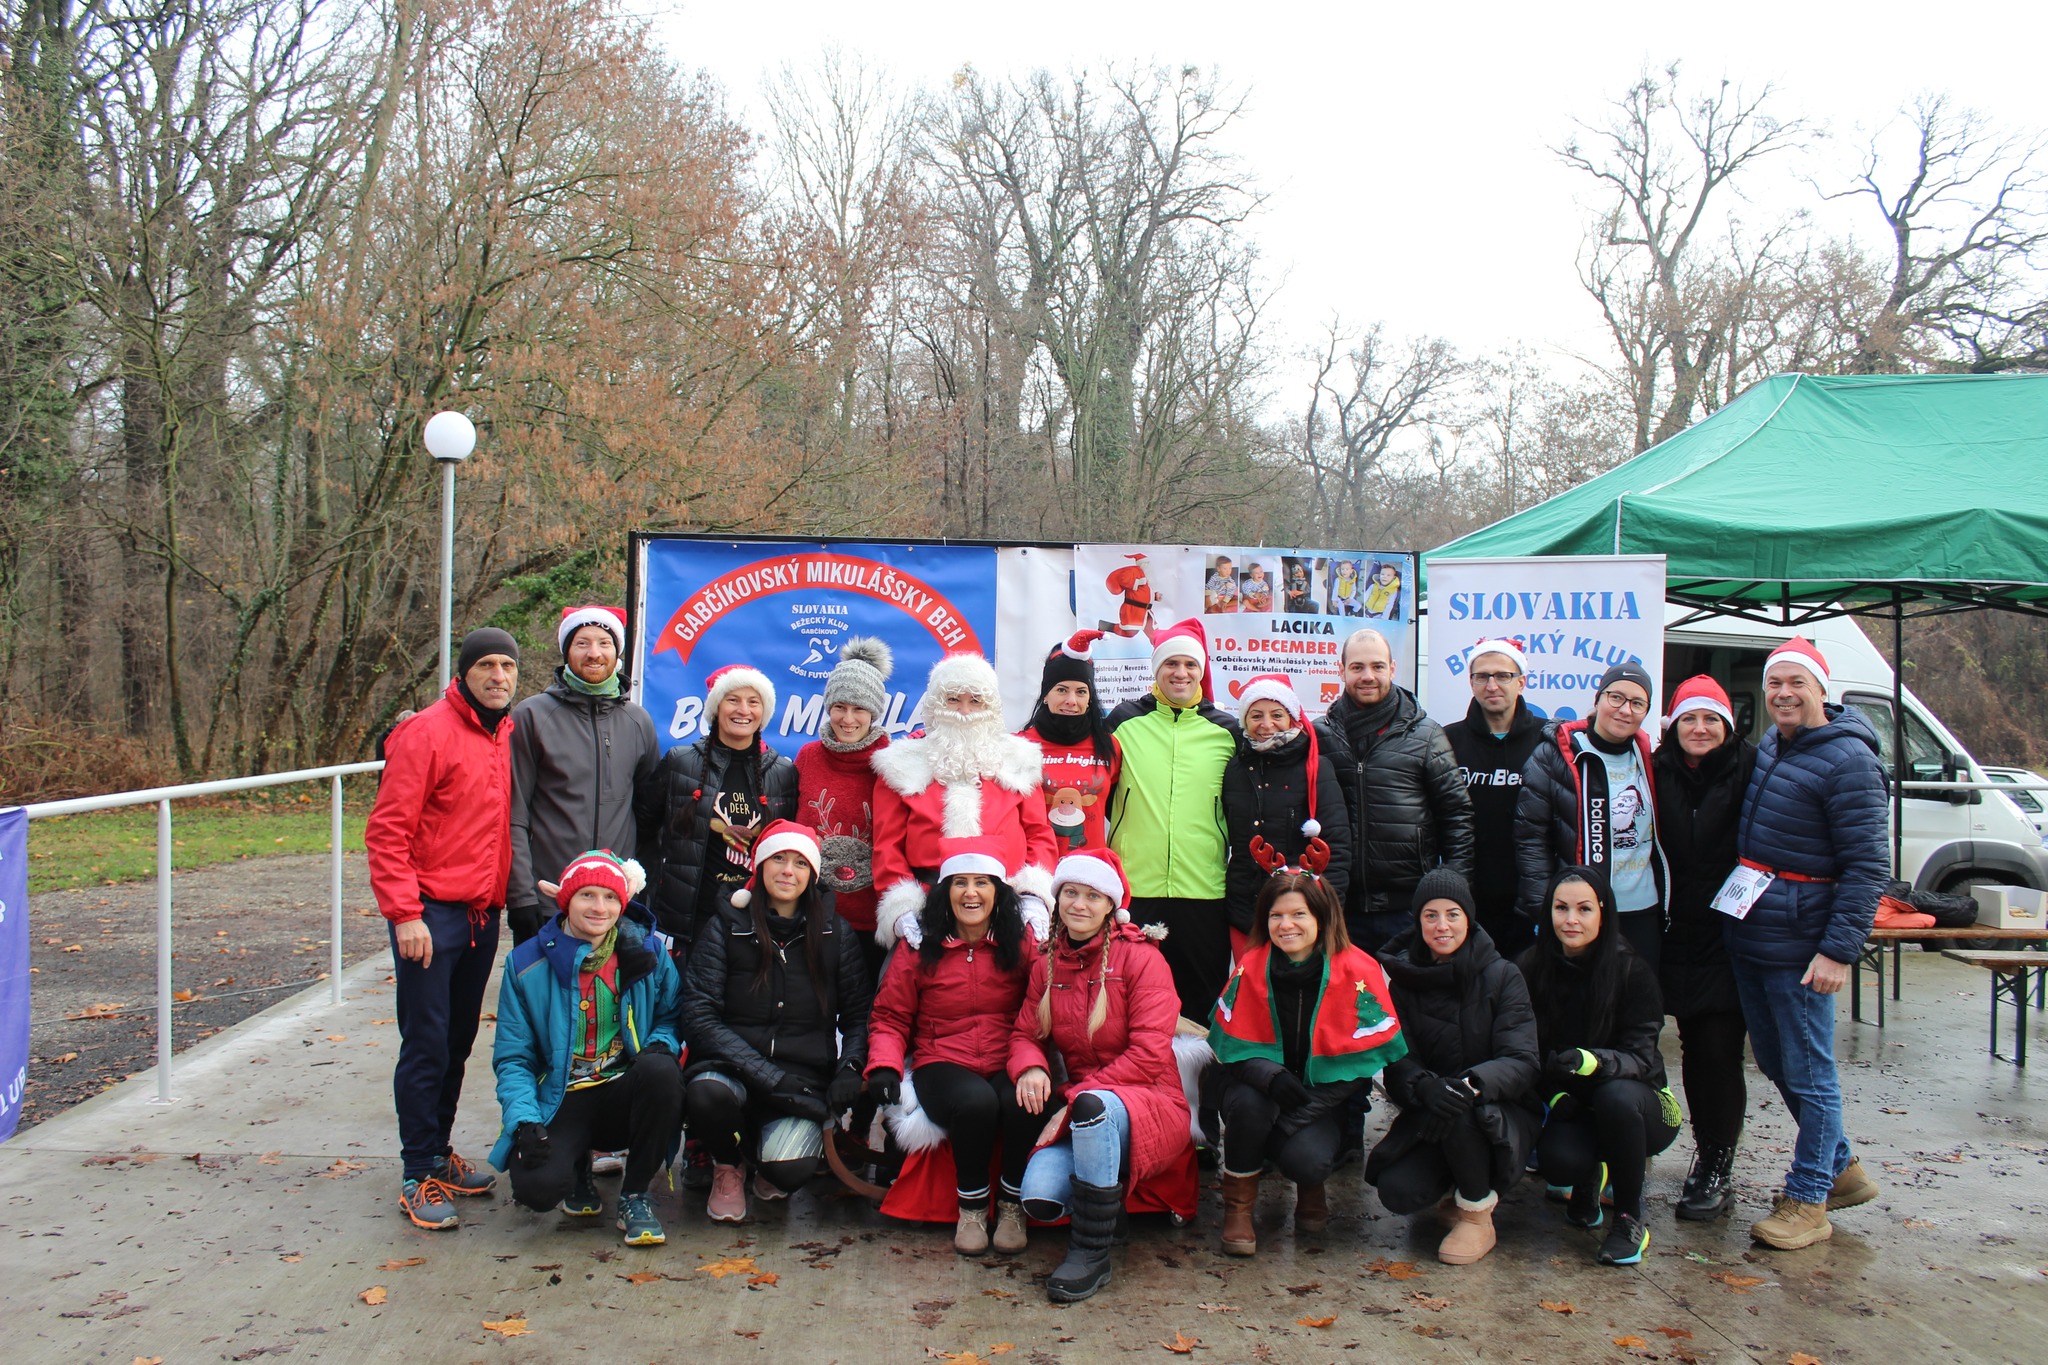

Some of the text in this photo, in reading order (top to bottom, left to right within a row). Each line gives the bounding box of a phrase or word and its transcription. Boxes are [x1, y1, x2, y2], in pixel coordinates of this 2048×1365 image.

[674, 558, 967, 648] GABČÍKOVSKÝ MIKULÁŠSKY BEH
[791, 604, 849, 615] SLOVAKIA
[1449, 591, 1641, 621] SLOVAKIA
[790, 615, 849, 632] BEŽECKÝ KLUB
[1271, 619, 1335, 635] LACIKA
[1215, 638, 1338, 655] 10. DECEMBER
[1268, 657, 1311, 667] Mikulášsky
[732, 792, 745, 802] OH
[729, 802, 751, 815] DEER
[1590, 798, 1606, 863] balance
[1724, 882, 1748, 900] 166
